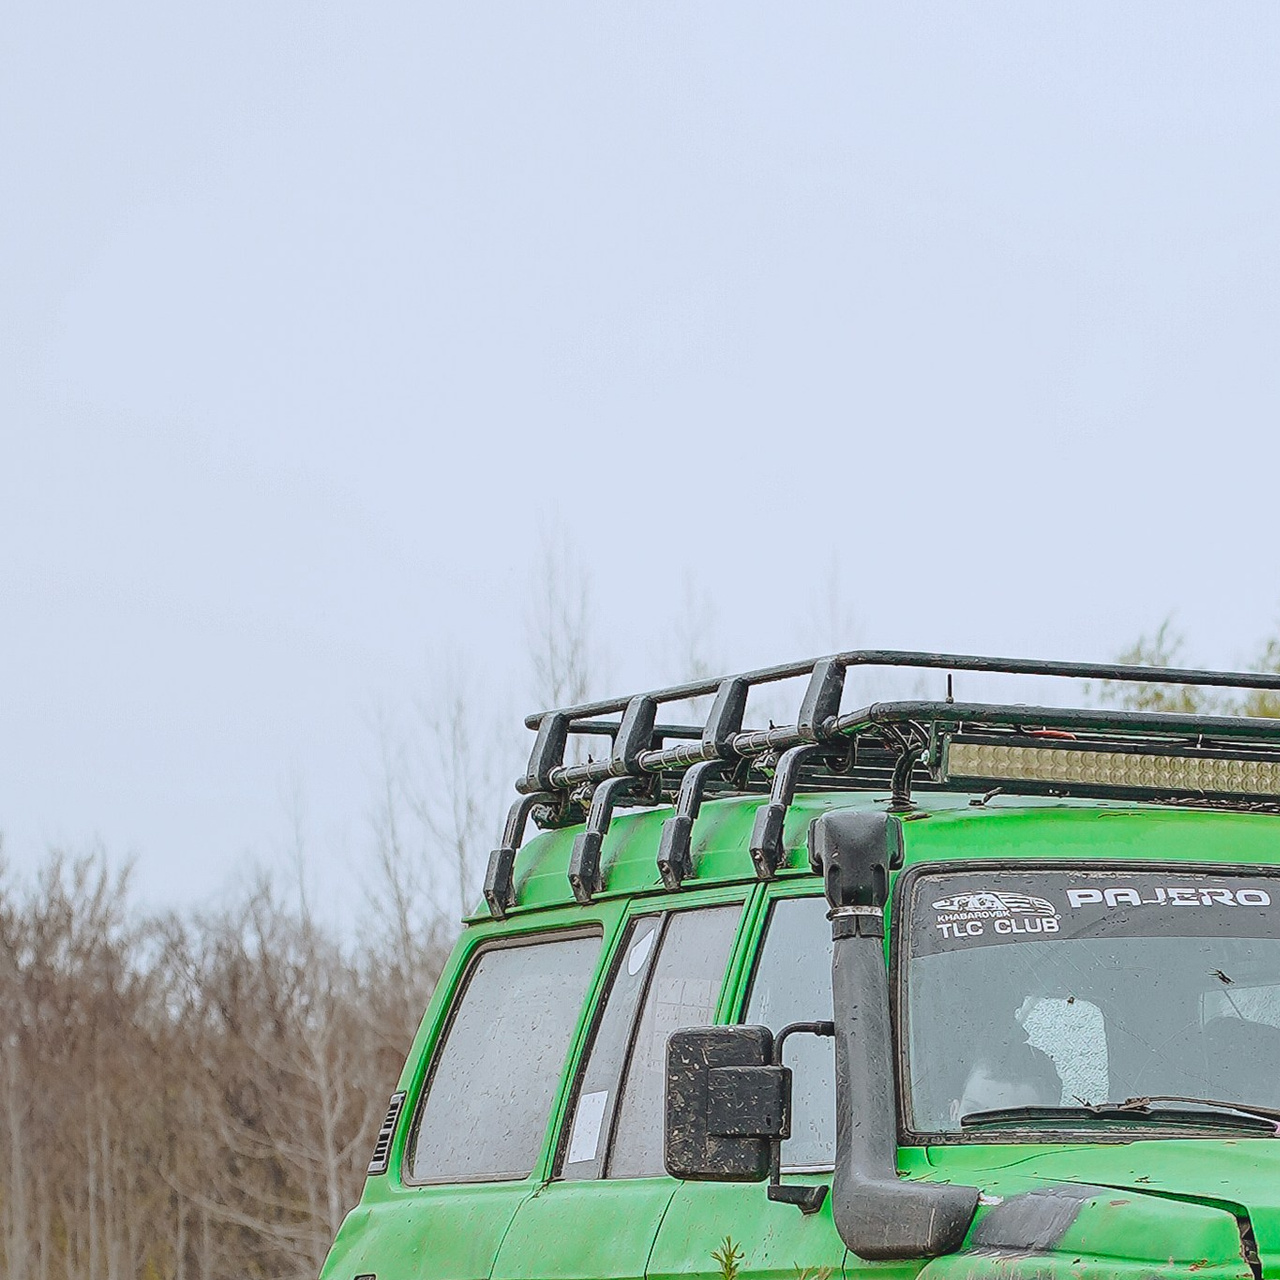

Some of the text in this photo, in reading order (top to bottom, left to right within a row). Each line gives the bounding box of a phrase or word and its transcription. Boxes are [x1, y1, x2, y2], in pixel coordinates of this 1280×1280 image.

[1066, 887, 1271, 908] PAJERO
[936, 918, 1060, 939] TLC CLUB
